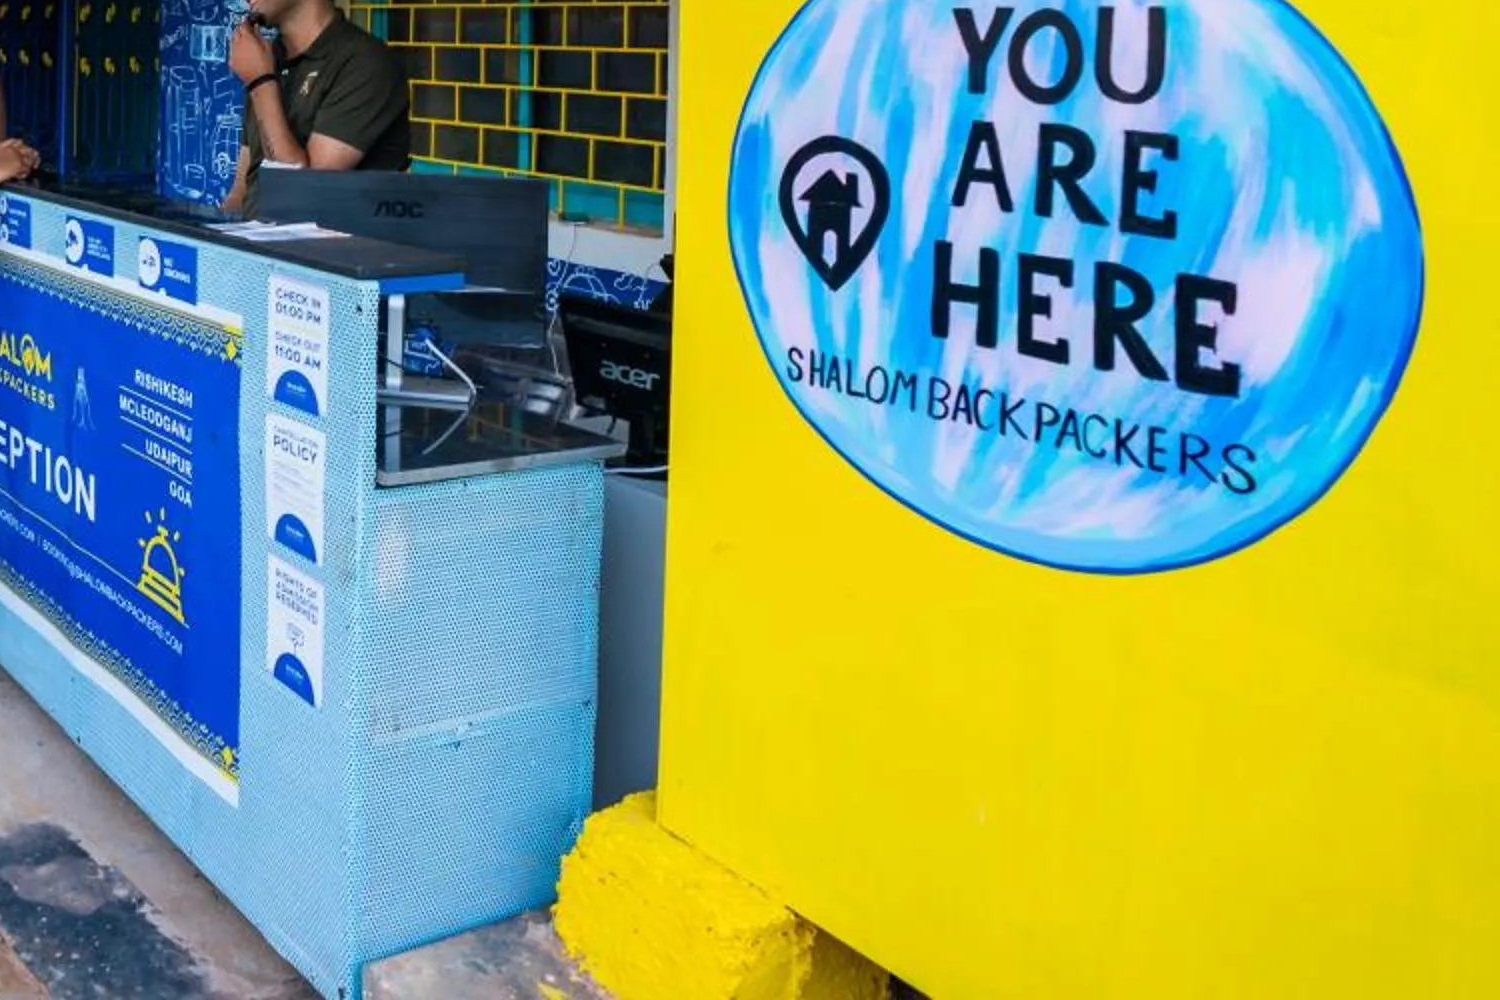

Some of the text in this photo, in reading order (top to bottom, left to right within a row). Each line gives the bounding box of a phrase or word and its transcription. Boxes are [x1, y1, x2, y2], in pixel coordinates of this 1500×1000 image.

[952, 6, 1168, 106] YOU
[951, 120, 1180, 241] ARE
[275, 287, 308, 305] CHECK
[306, 310, 322, 324] PM
[930, 241, 1241, 400] HERE
[275, 345, 321, 371] 11:00 AM
[599, 360, 660, 391] acer
[134, 369, 193, 409] RISHIKESH
[119, 395, 193, 443] MCLEODGANJ
[787, 347, 1258, 495] SHALOM BACKPACKERS
[145, 440, 193, 479] UDAIPUR
[273, 434, 318, 465] POLICY
[169, 480, 193, 508] GOA
